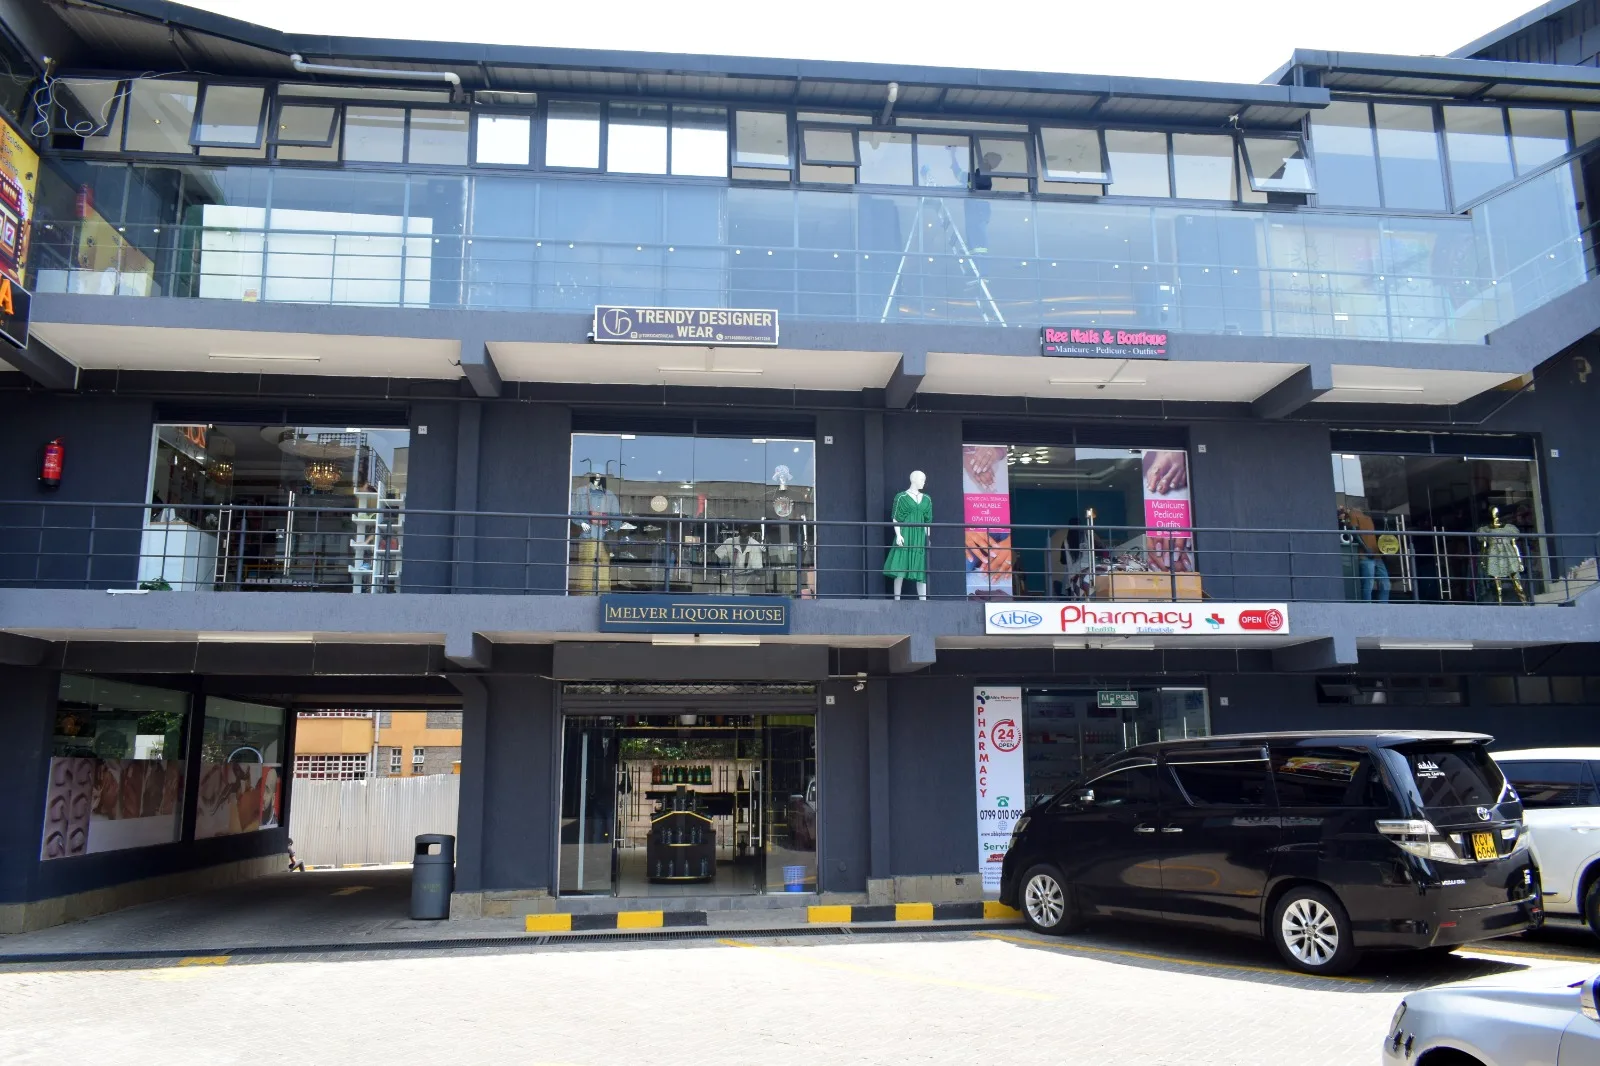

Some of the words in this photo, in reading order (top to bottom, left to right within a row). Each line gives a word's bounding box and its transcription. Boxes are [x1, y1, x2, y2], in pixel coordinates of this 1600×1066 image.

[636, 309, 694, 324] TRENDY
[698, 311, 772, 326] DESIGNER
[677, 325, 713, 338] WEAR
[1046, 328, 1068, 343] Ree
[1070, 329, 1099, 344] Nails
[1101, 330, 1114, 345] &
[1117, 330, 1167, 346] Boutique
[1055, 346, 1089, 354] Manicure
[1096, 347, 1126, 355] Pedicure
[1132, 347, 1158, 355] Outfits
[1151, 501, 1185, 509] Manicure
[1153, 510, 1184, 519] Pedicure
[1156, 520, 1180, 528] Outfits
[609, 607, 668, 619] MELVER
[671, 608, 729, 622] LIQUOR
[732, 609, 782, 621] HOUSE
[997, 612, 1039, 625] Aible
[1241, 616, 1262, 624] OPEN
[998, 728, 1014, 740] 24
[977, 706, 989, 798] PHARMACY
[980, 809, 996, 820] 0799
[997, 809, 1009, 820] 010
[984, 841, 1008, 851] Servi
[1474, 834, 1488, 847] KCV
[1477, 846, 1497, 859] 606M
